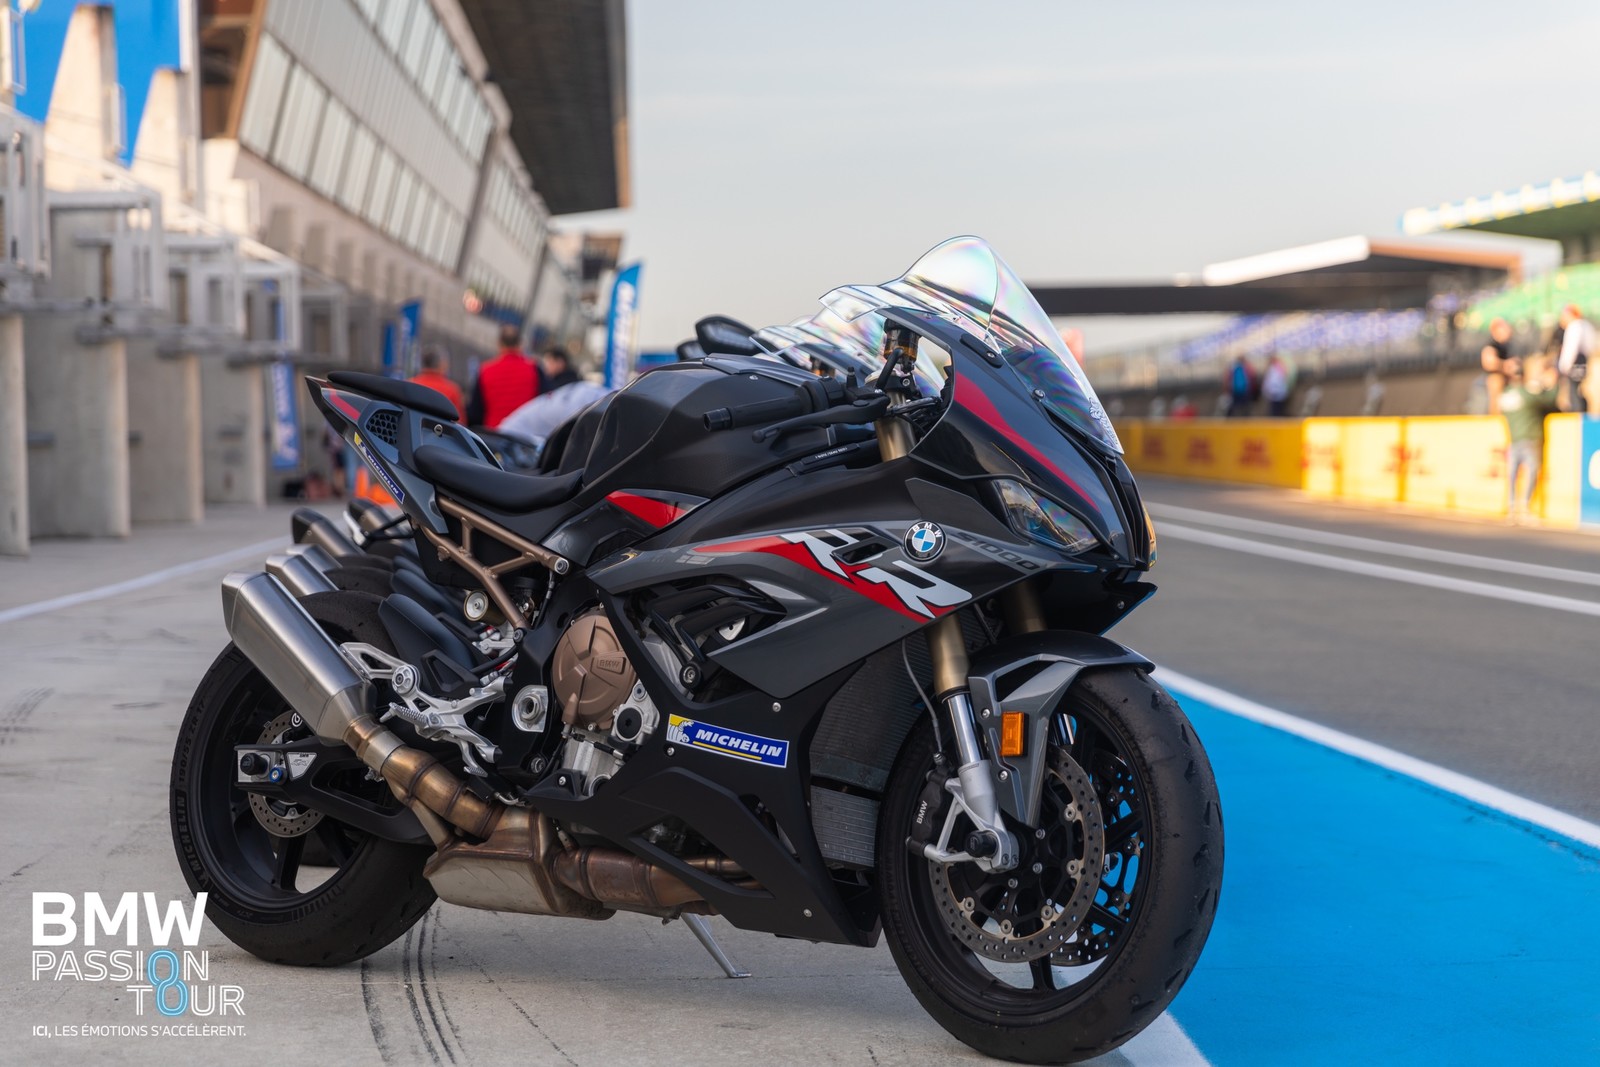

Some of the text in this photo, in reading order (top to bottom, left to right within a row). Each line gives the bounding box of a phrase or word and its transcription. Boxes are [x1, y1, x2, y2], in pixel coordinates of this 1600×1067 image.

[367, 455, 399, 494] MICHELIN
[956, 531, 1041, 571] S1000
[695, 729, 783, 757] MICHELIN
[916, 800, 928, 824] BMW
[177, 796, 202, 872] MICHELIN
